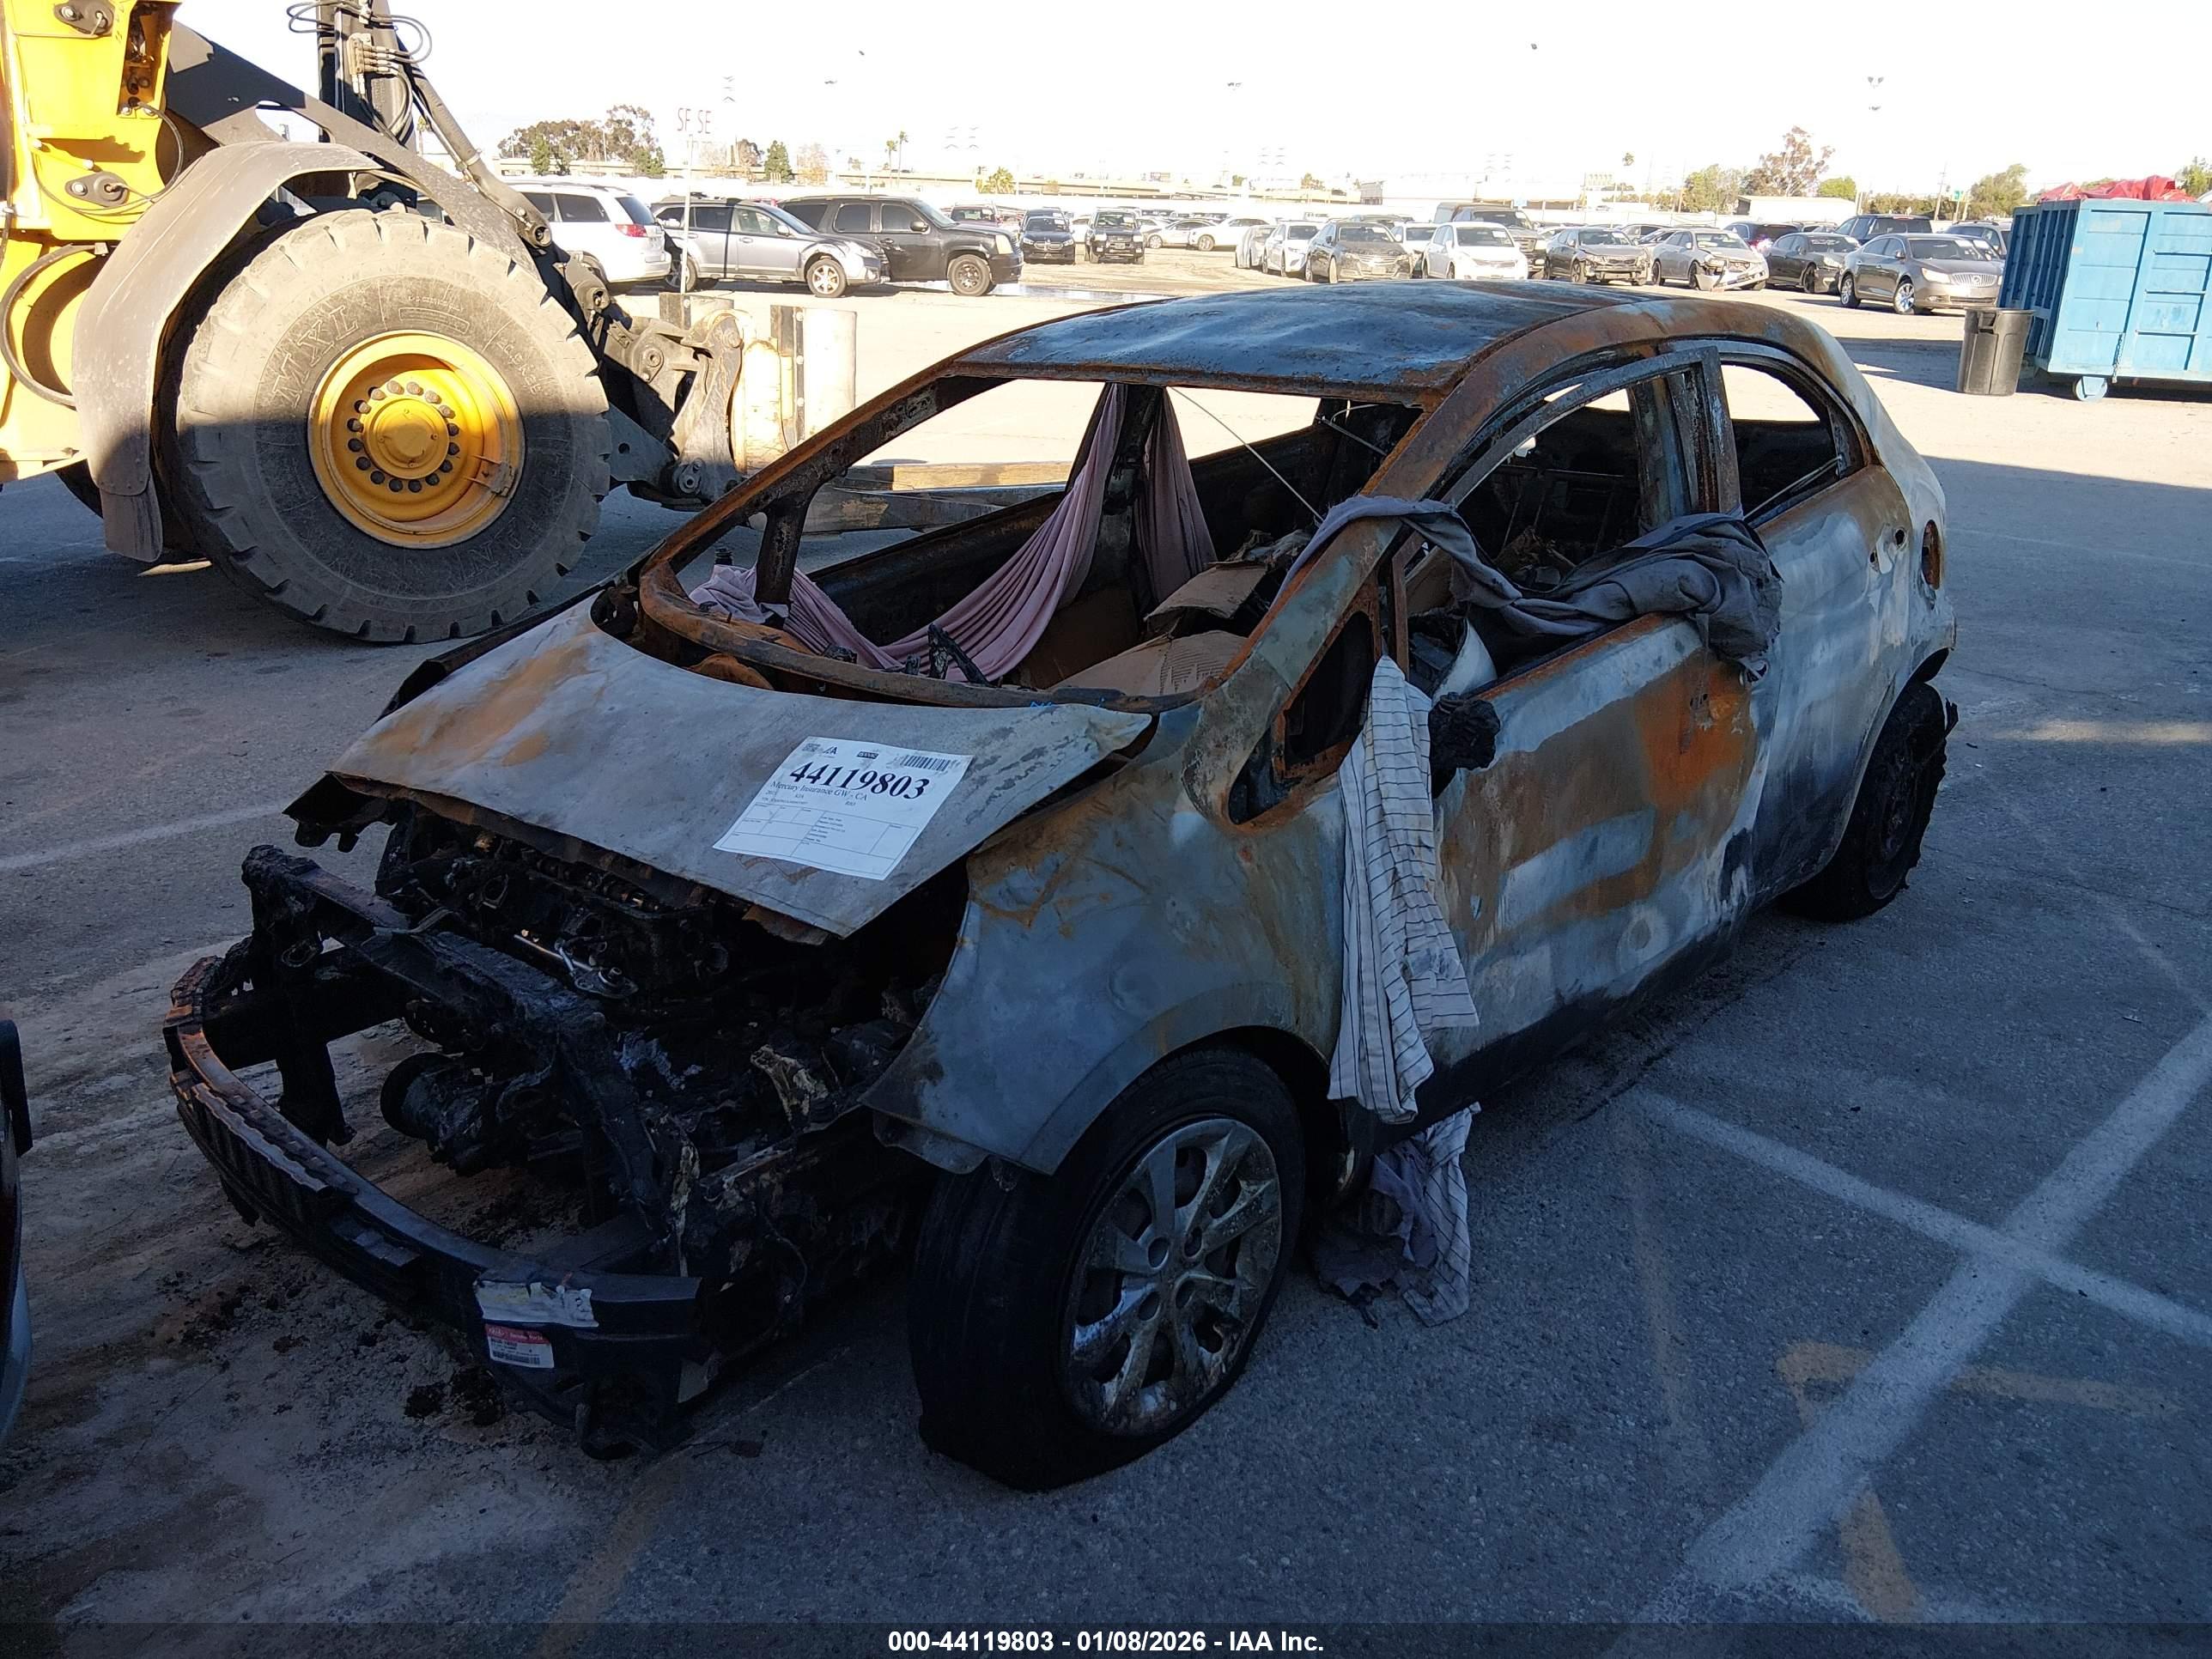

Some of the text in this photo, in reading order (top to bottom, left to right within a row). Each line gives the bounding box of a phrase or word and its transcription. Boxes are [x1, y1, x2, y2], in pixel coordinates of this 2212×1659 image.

[770, 780, 798, 792] Mercury
[799, 785, 834, 795] Insurance
[854, 792, 867, 801] CA
[789, 762, 930, 799] 44119803
